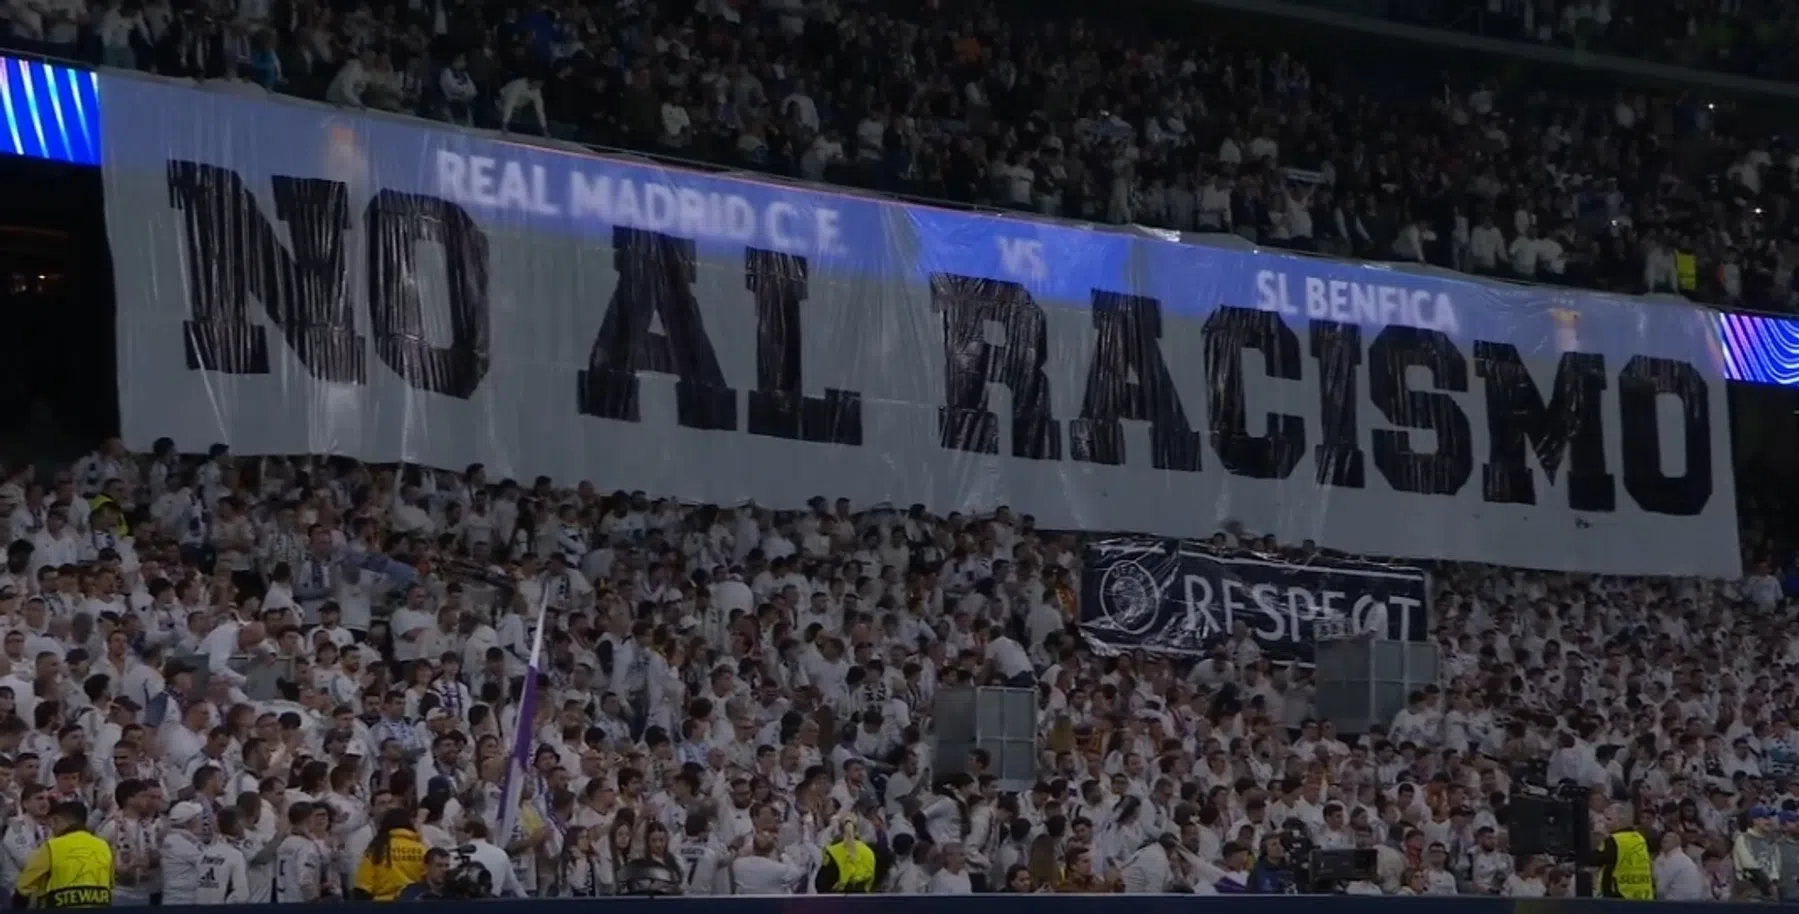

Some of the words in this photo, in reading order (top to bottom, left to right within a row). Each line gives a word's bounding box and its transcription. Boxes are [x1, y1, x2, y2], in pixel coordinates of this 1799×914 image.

[435, 149, 557, 216] REAL
[568, 169, 754, 240] MADRID
[1000, 236, 1048, 281] VS
[1256, 269, 1297, 316] SL
[1305, 276, 1460, 333] BENFICA
[167, 159, 489, 399] NO
[577, 224, 862, 446] AL
[930, 271, 1714, 516] RACISMO
[54, 888, 110, 906] STEWAR
